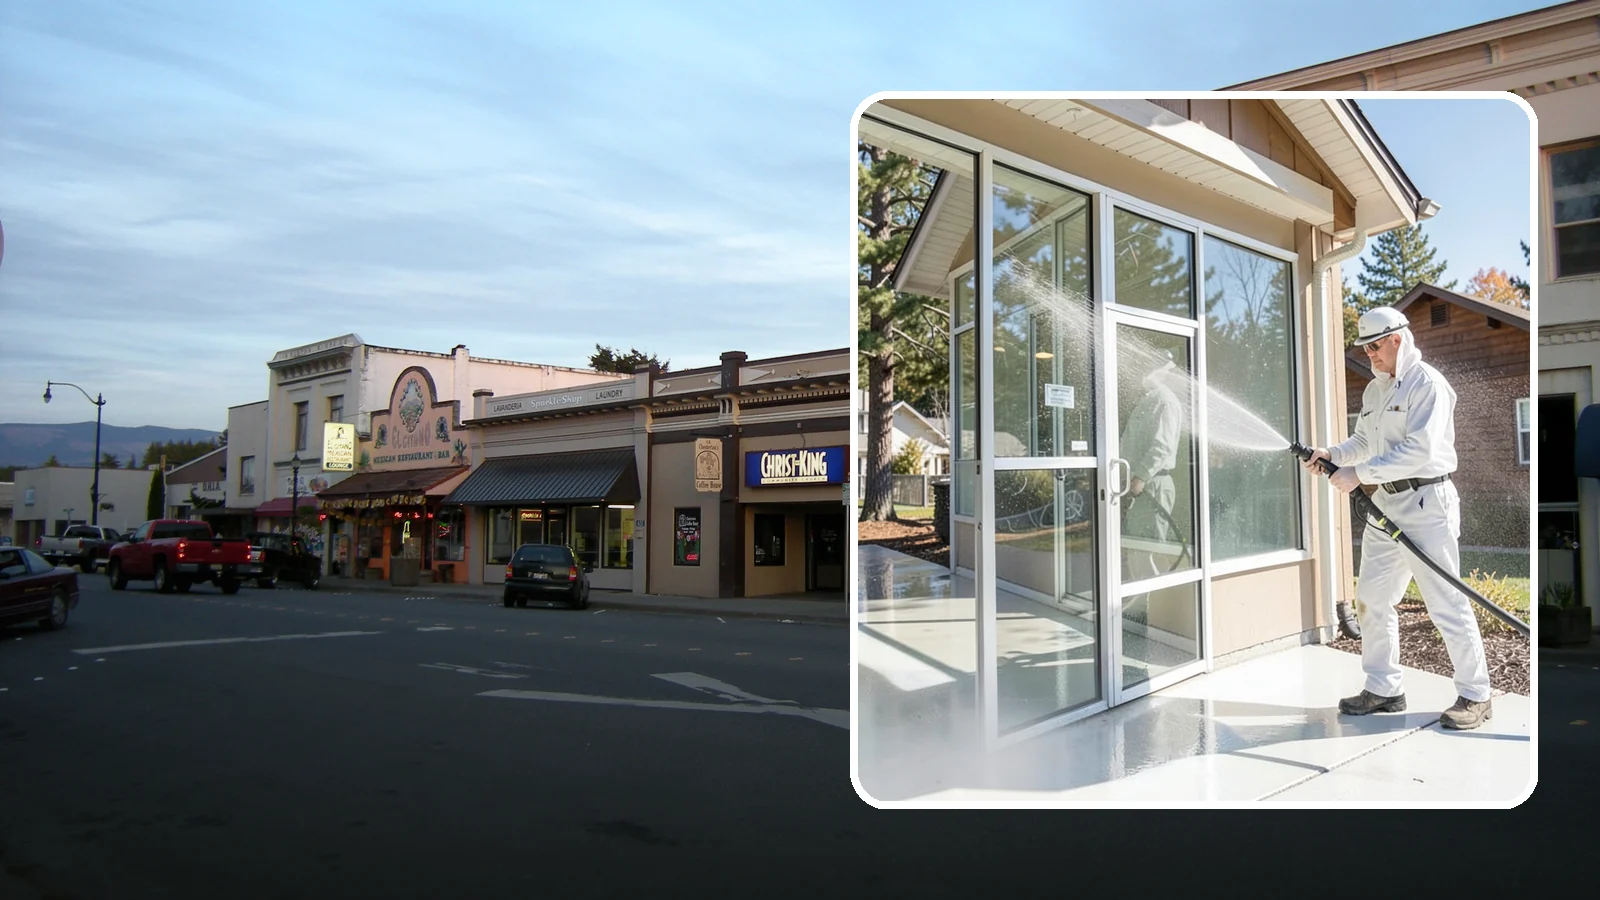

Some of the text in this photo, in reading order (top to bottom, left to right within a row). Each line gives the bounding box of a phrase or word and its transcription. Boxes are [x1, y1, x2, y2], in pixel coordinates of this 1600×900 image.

[493, 389, 624, 412] LAVANDERIA Sparkle Shop LAUNDRY
[373, 450, 450, 464] MEXICAN RESTAURANT BAR
[760, 450, 827, 478] CHRIST KING
